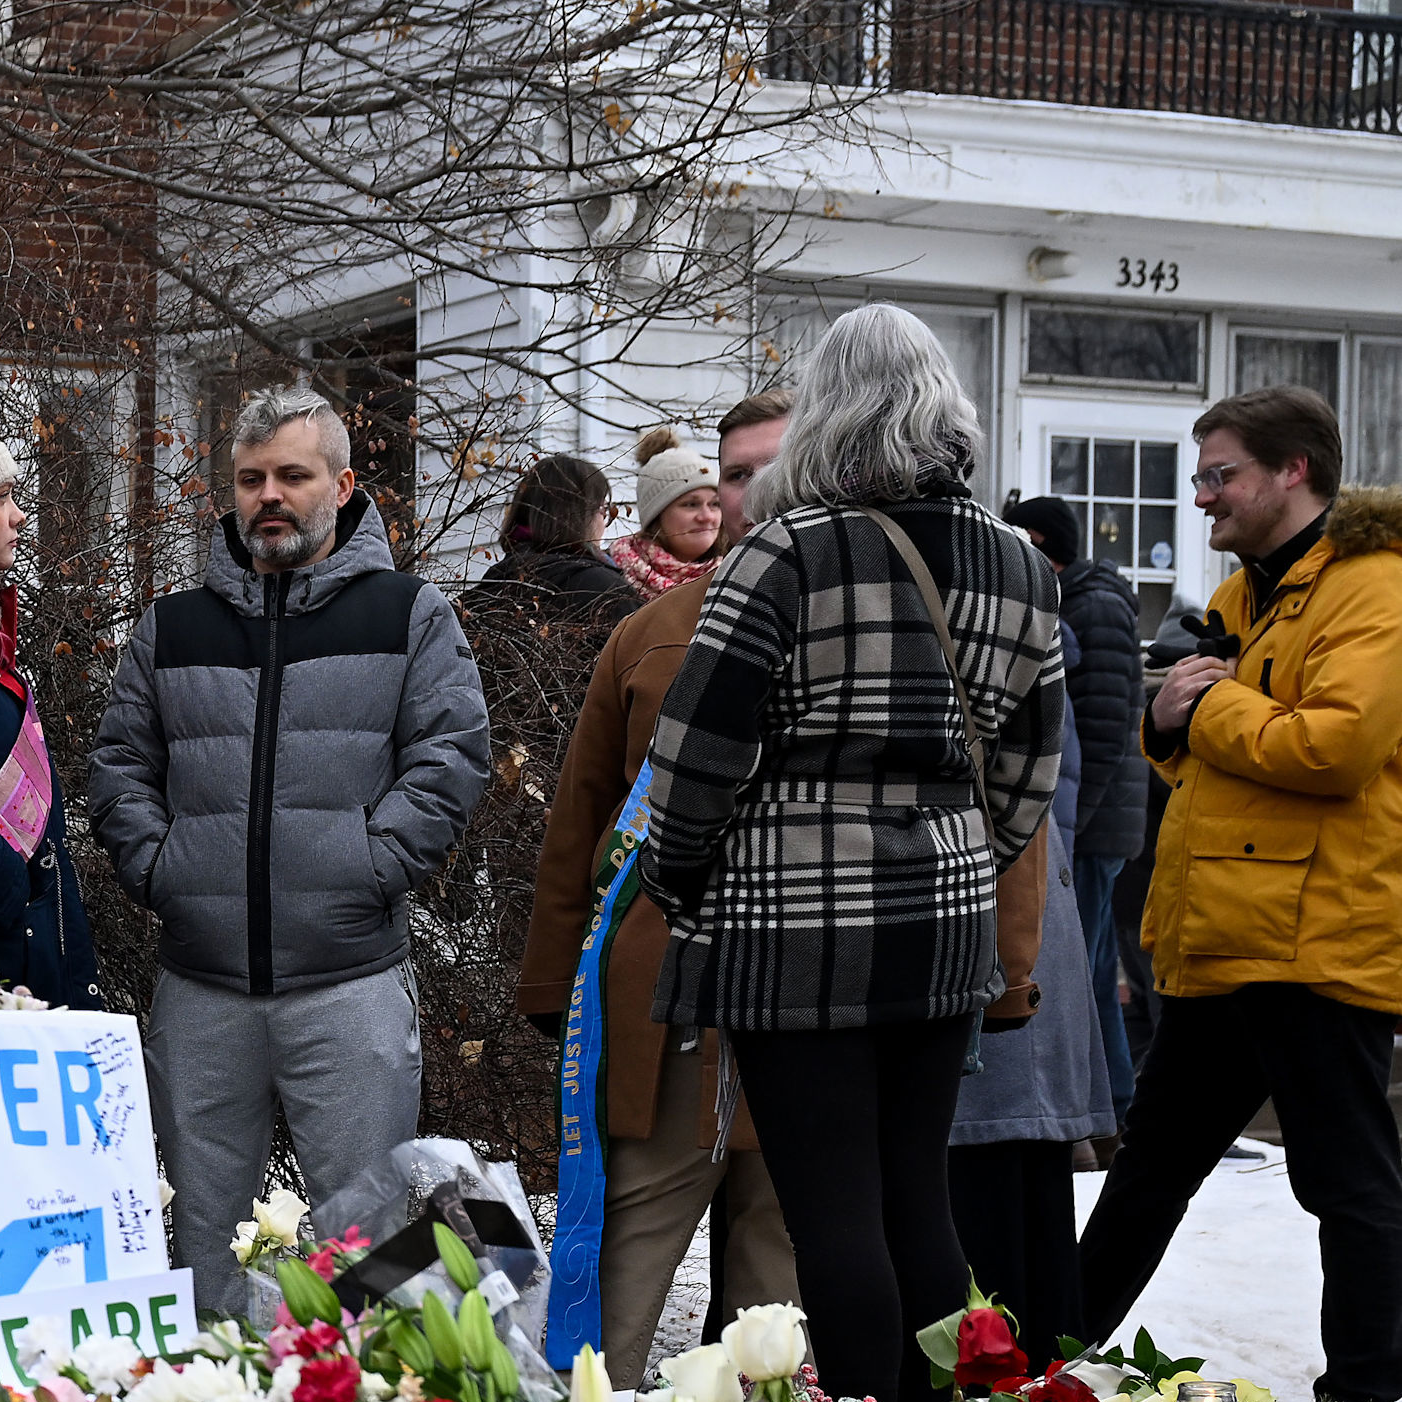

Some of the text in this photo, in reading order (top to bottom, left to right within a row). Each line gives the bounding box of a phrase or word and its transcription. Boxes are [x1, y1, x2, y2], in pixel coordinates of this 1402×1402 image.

[1116, 257, 1179, 293] 3343
[582, 885, 612, 951] ROLL
[563, 971, 587, 1096] JUSTICE
[563, 1114, 583, 1156] LET
[71, 1294, 178, 1357] ARE
